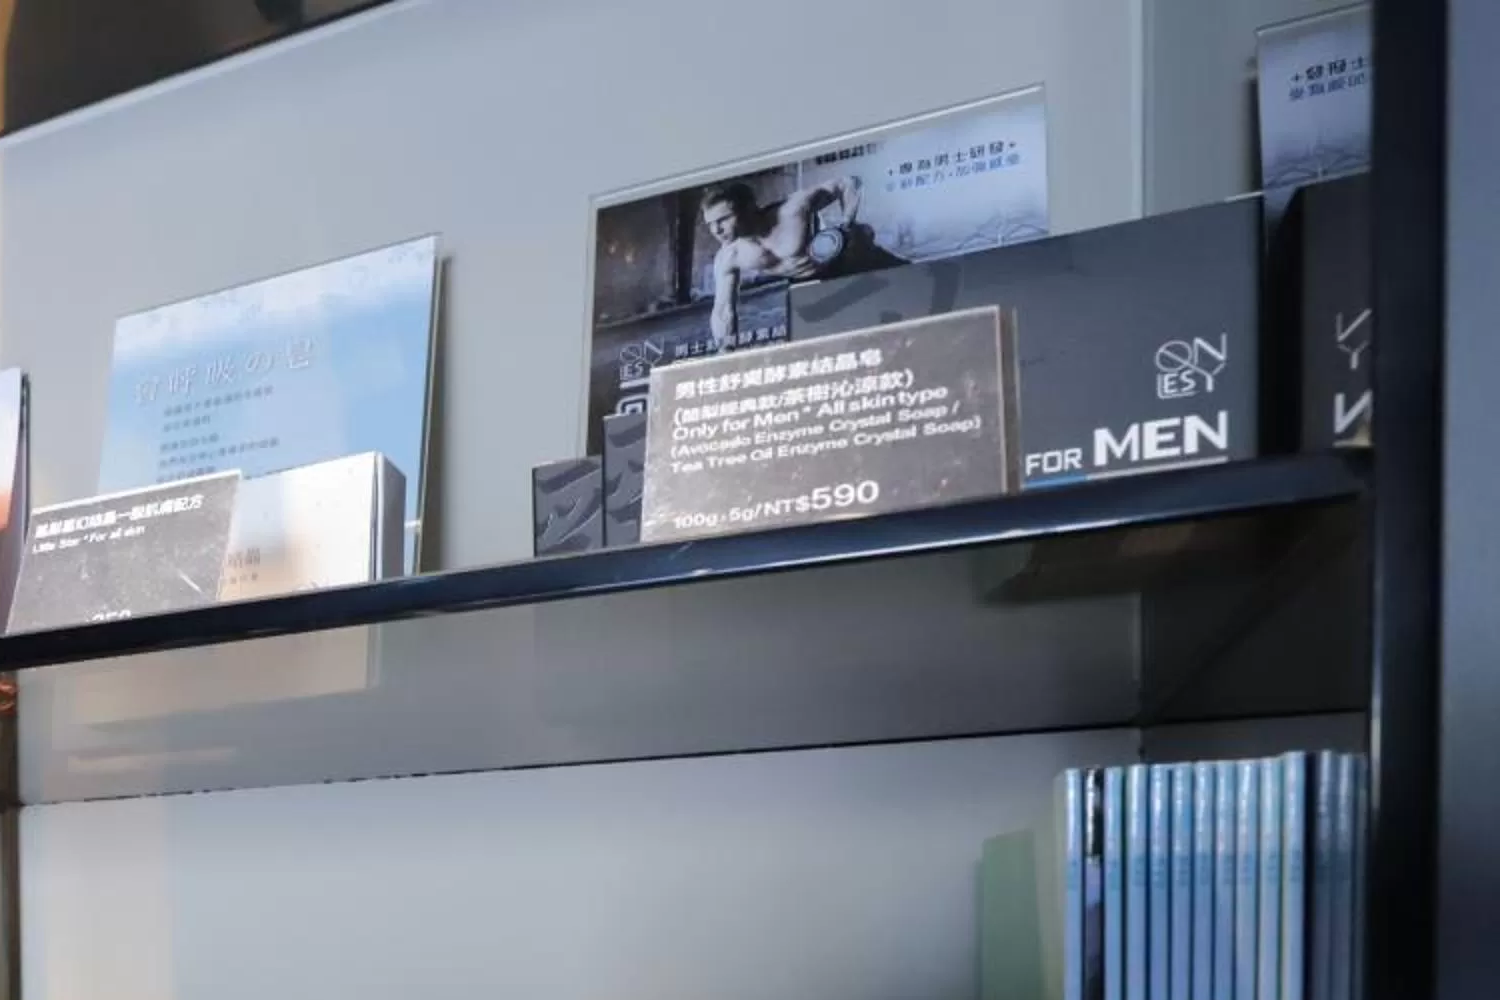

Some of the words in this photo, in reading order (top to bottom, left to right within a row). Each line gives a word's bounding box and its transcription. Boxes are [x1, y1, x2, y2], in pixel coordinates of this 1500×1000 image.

[671, 422, 718, 442] Only
[721, 416, 750, 433] for
[753, 410, 799, 428] Men
[816, 399, 846, 418] All
[849, 391, 894, 412] skin
[898, 386, 949, 409] type
[708, 452, 747, 470] Tree
[777, 436, 848, 459] Enzyme
[853, 424, 918, 447] Crystal
[922, 414, 983, 437] Soap)
[755, 423, 824, 447] Enzyme
[828, 411, 892, 434] Crystal
[898, 402, 947, 424] Soap
[1025, 447, 1083, 477] FOR
[1093, 409, 1228, 468] MEN
